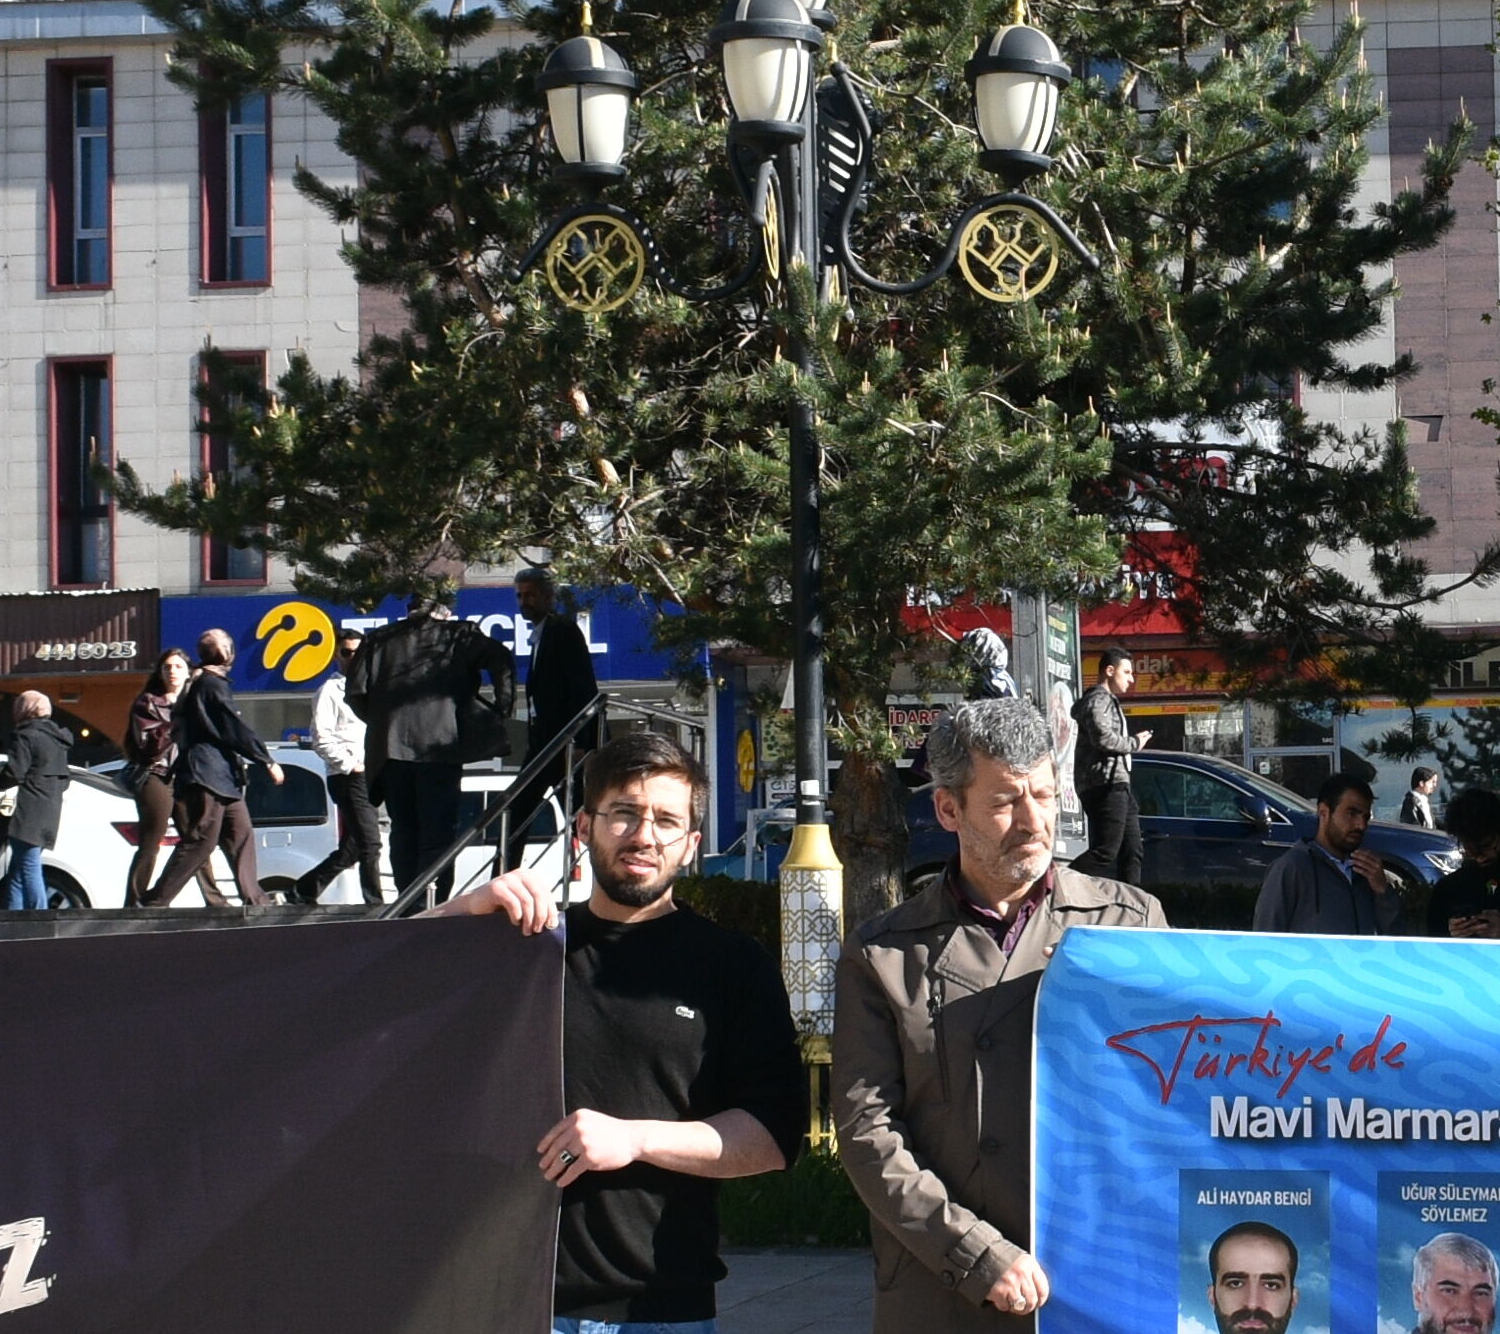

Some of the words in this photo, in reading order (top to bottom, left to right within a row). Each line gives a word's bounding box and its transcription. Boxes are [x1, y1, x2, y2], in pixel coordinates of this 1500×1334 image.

[35, 643, 76, 661] 444
[77, 642, 108, 660] 60
[1210, 1096, 1313, 1139] Mavi
[1197, 1187, 1218, 1206] ALİ
[1220, 1190, 1272, 1206] HAYDAR
[1274, 1188, 1312, 1206] BENGİ
[1401, 1183, 1437, 1202] UĞUR
[1420, 1206, 1489, 1224] SÖYLEMEZ
